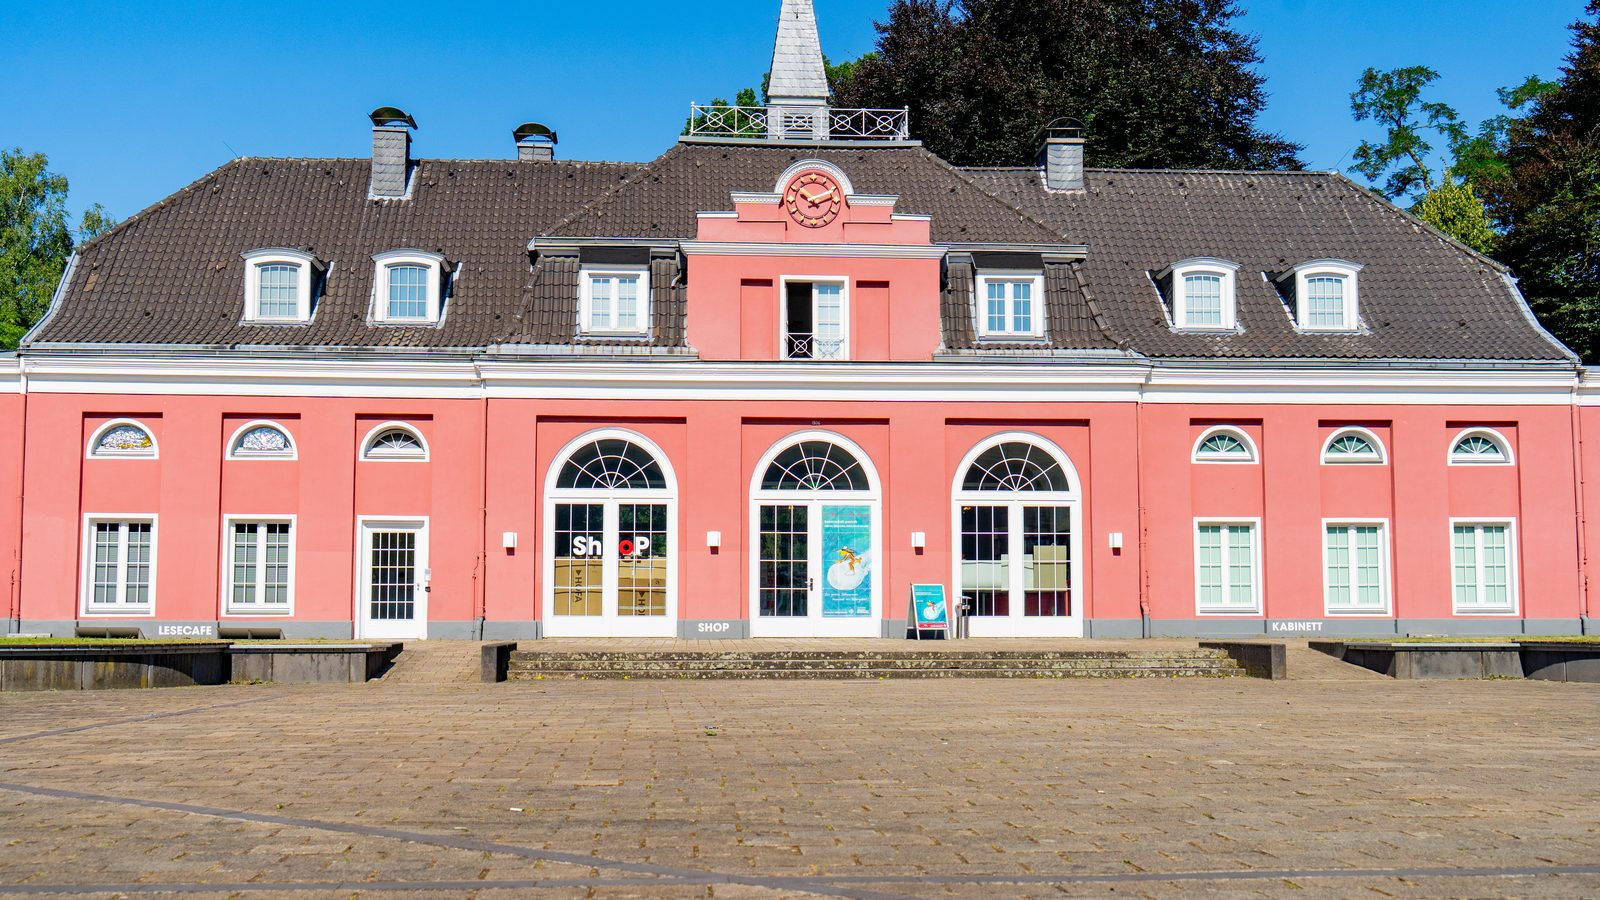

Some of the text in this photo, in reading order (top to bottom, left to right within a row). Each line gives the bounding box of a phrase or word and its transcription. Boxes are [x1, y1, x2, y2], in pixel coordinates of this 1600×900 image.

[158, 625, 212, 635] LESECAFE
[697, 622, 730, 632] SHOP
[1272, 621, 1323, 631] KABINETT
